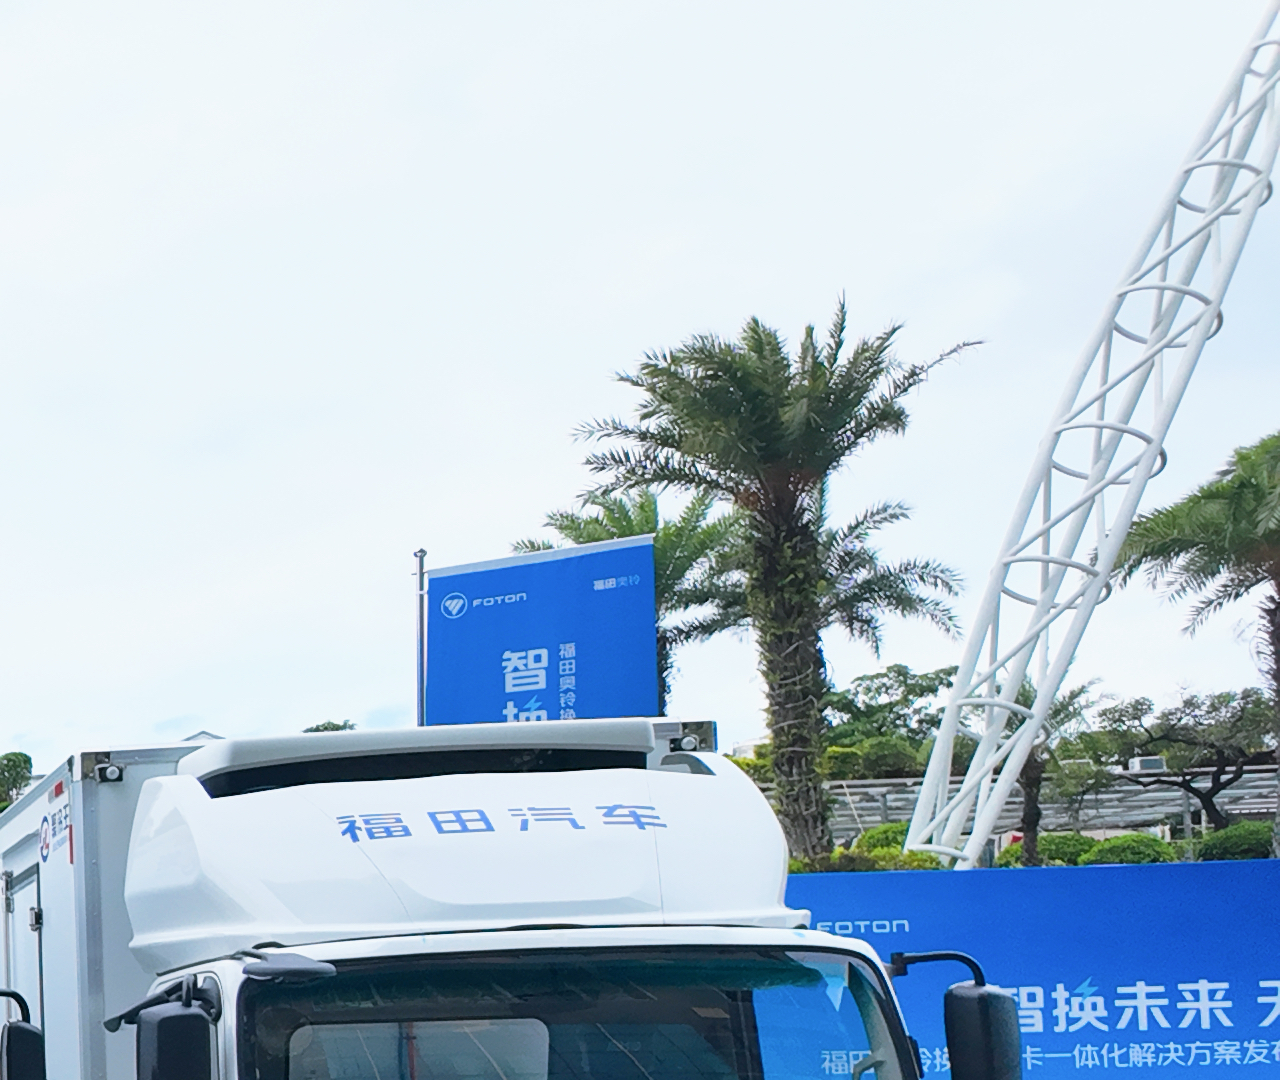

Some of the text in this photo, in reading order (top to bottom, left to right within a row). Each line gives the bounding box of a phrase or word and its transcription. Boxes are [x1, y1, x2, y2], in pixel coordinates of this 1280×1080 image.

[473, 592, 527, 607] FOTON
[336, 803, 668, 844] 福田汽车
[816, 919, 910, 936] FOTON
